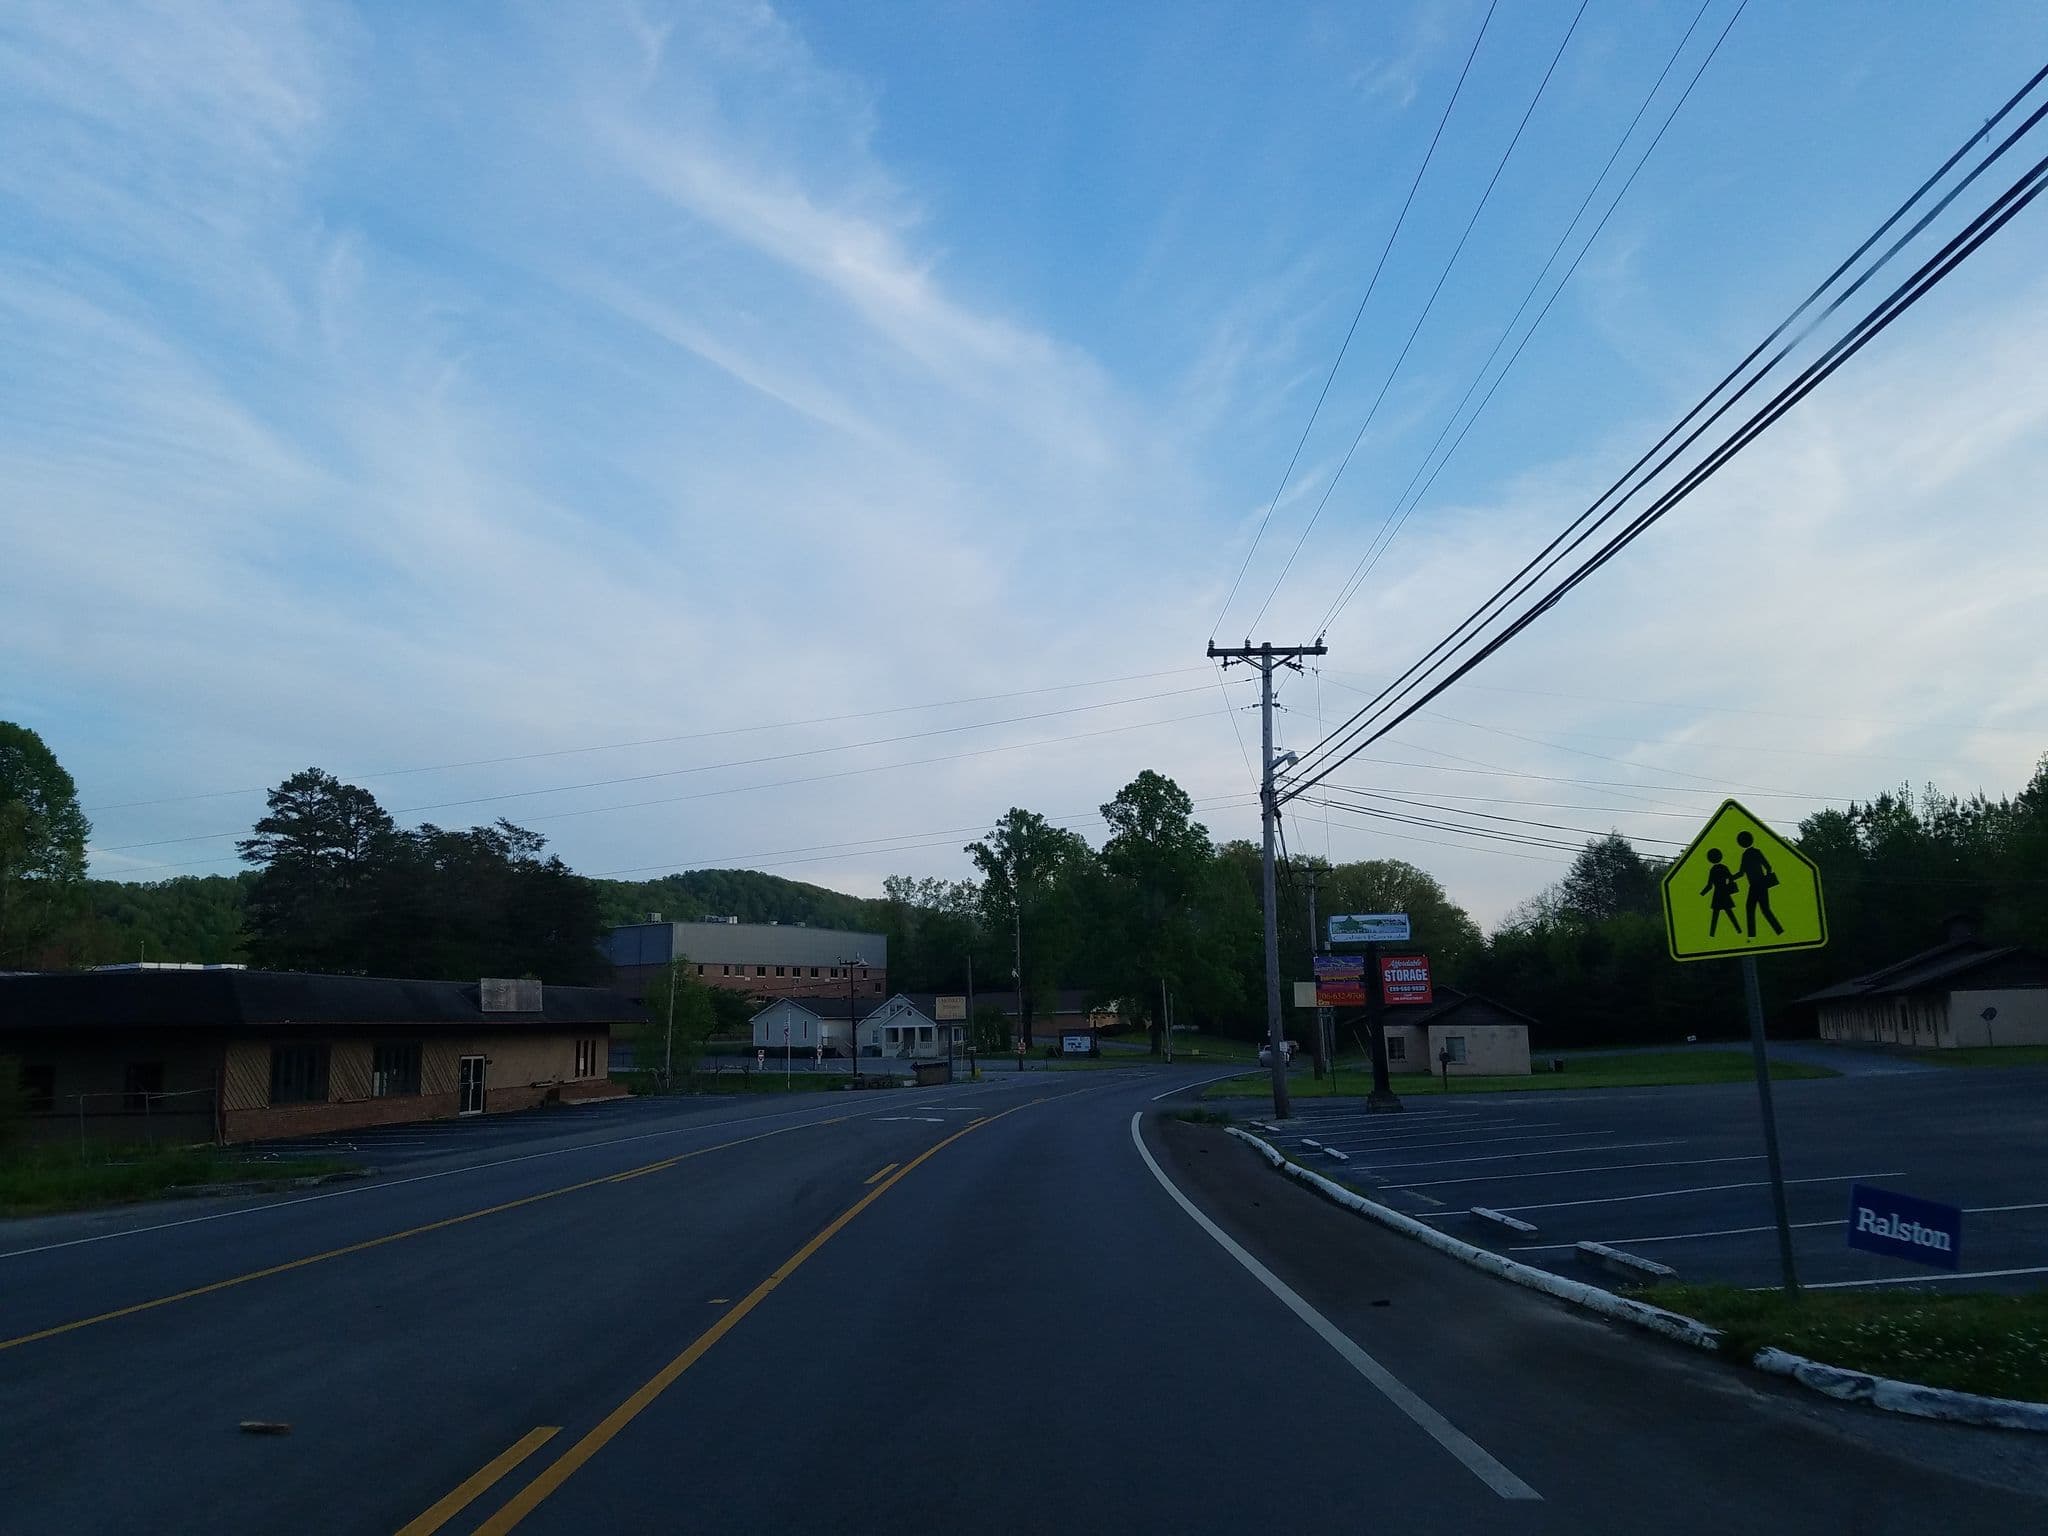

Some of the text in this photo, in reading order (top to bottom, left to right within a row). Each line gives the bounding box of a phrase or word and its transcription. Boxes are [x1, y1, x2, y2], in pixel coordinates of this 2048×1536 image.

[1388, 959, 1422, 968] Affordable
[1384, 969, 1428, 981] STORAGE
[1856, 1206, 1952, 1252] Ralston
